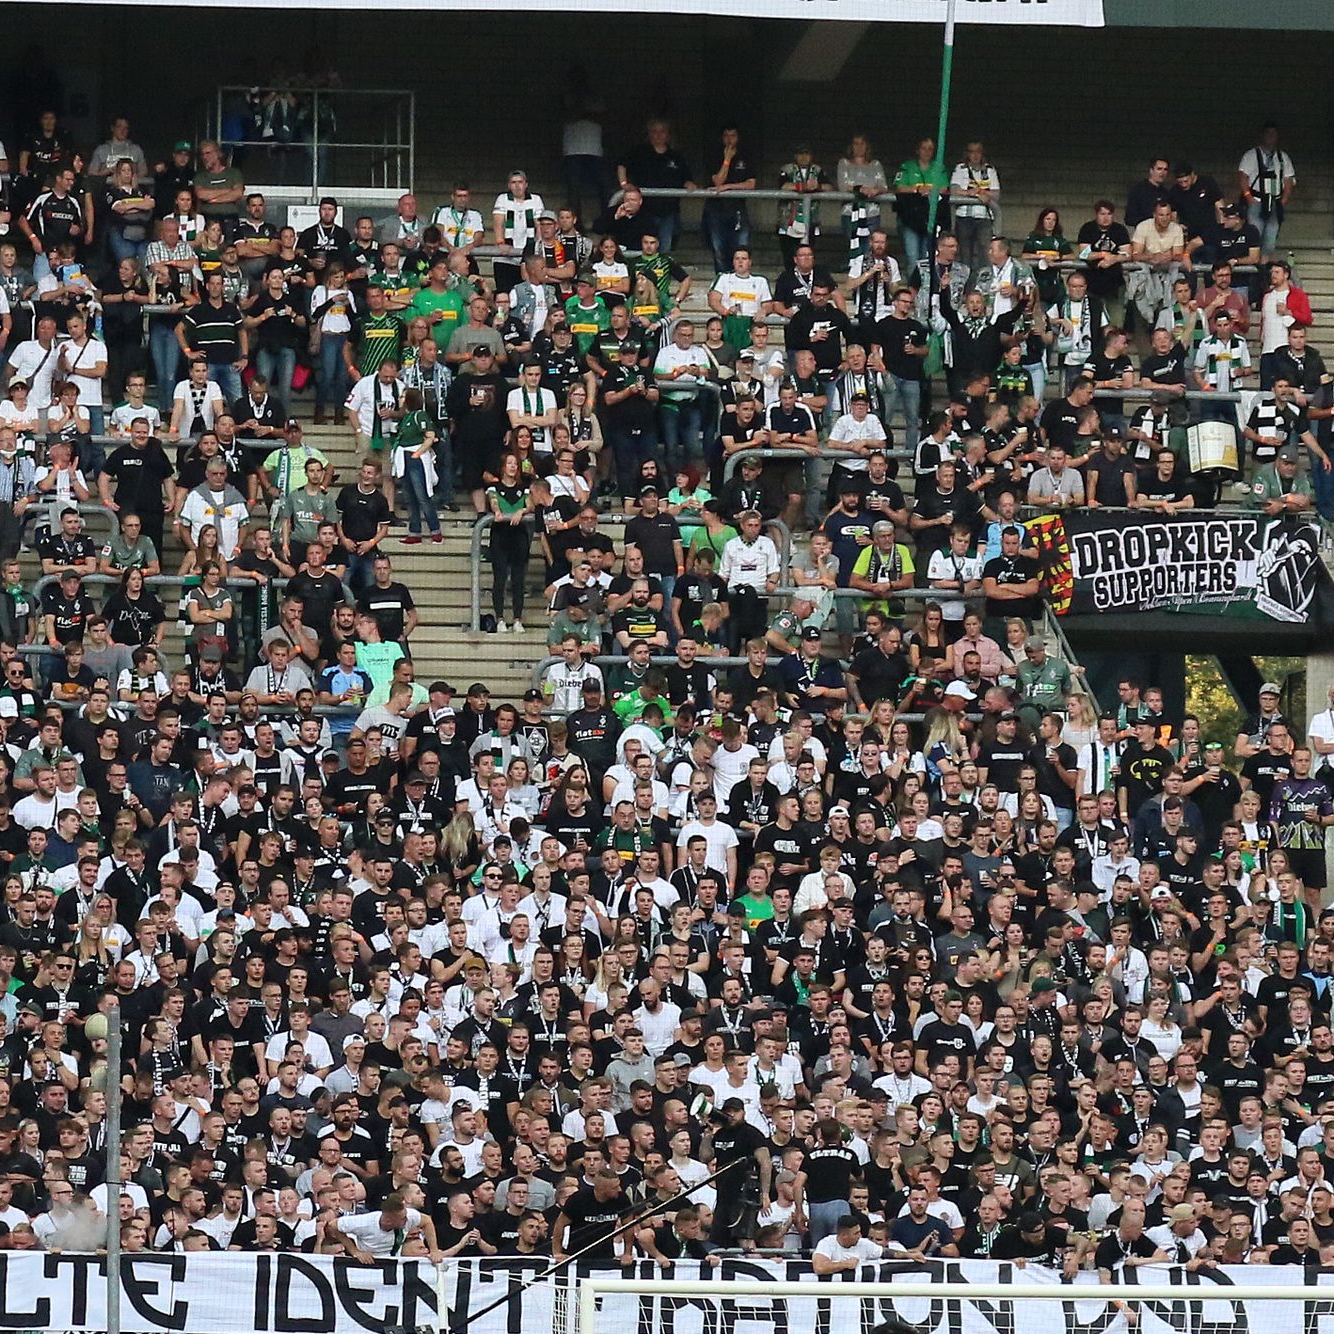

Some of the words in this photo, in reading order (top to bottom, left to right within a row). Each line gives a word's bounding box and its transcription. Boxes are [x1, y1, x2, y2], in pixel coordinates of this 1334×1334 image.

[1072, 520, 1259, 578] DROPKICK
[1093, 561, 1238, 609] SUPPORTERS
[808, 1147, 854, 1162] ULTRAS
